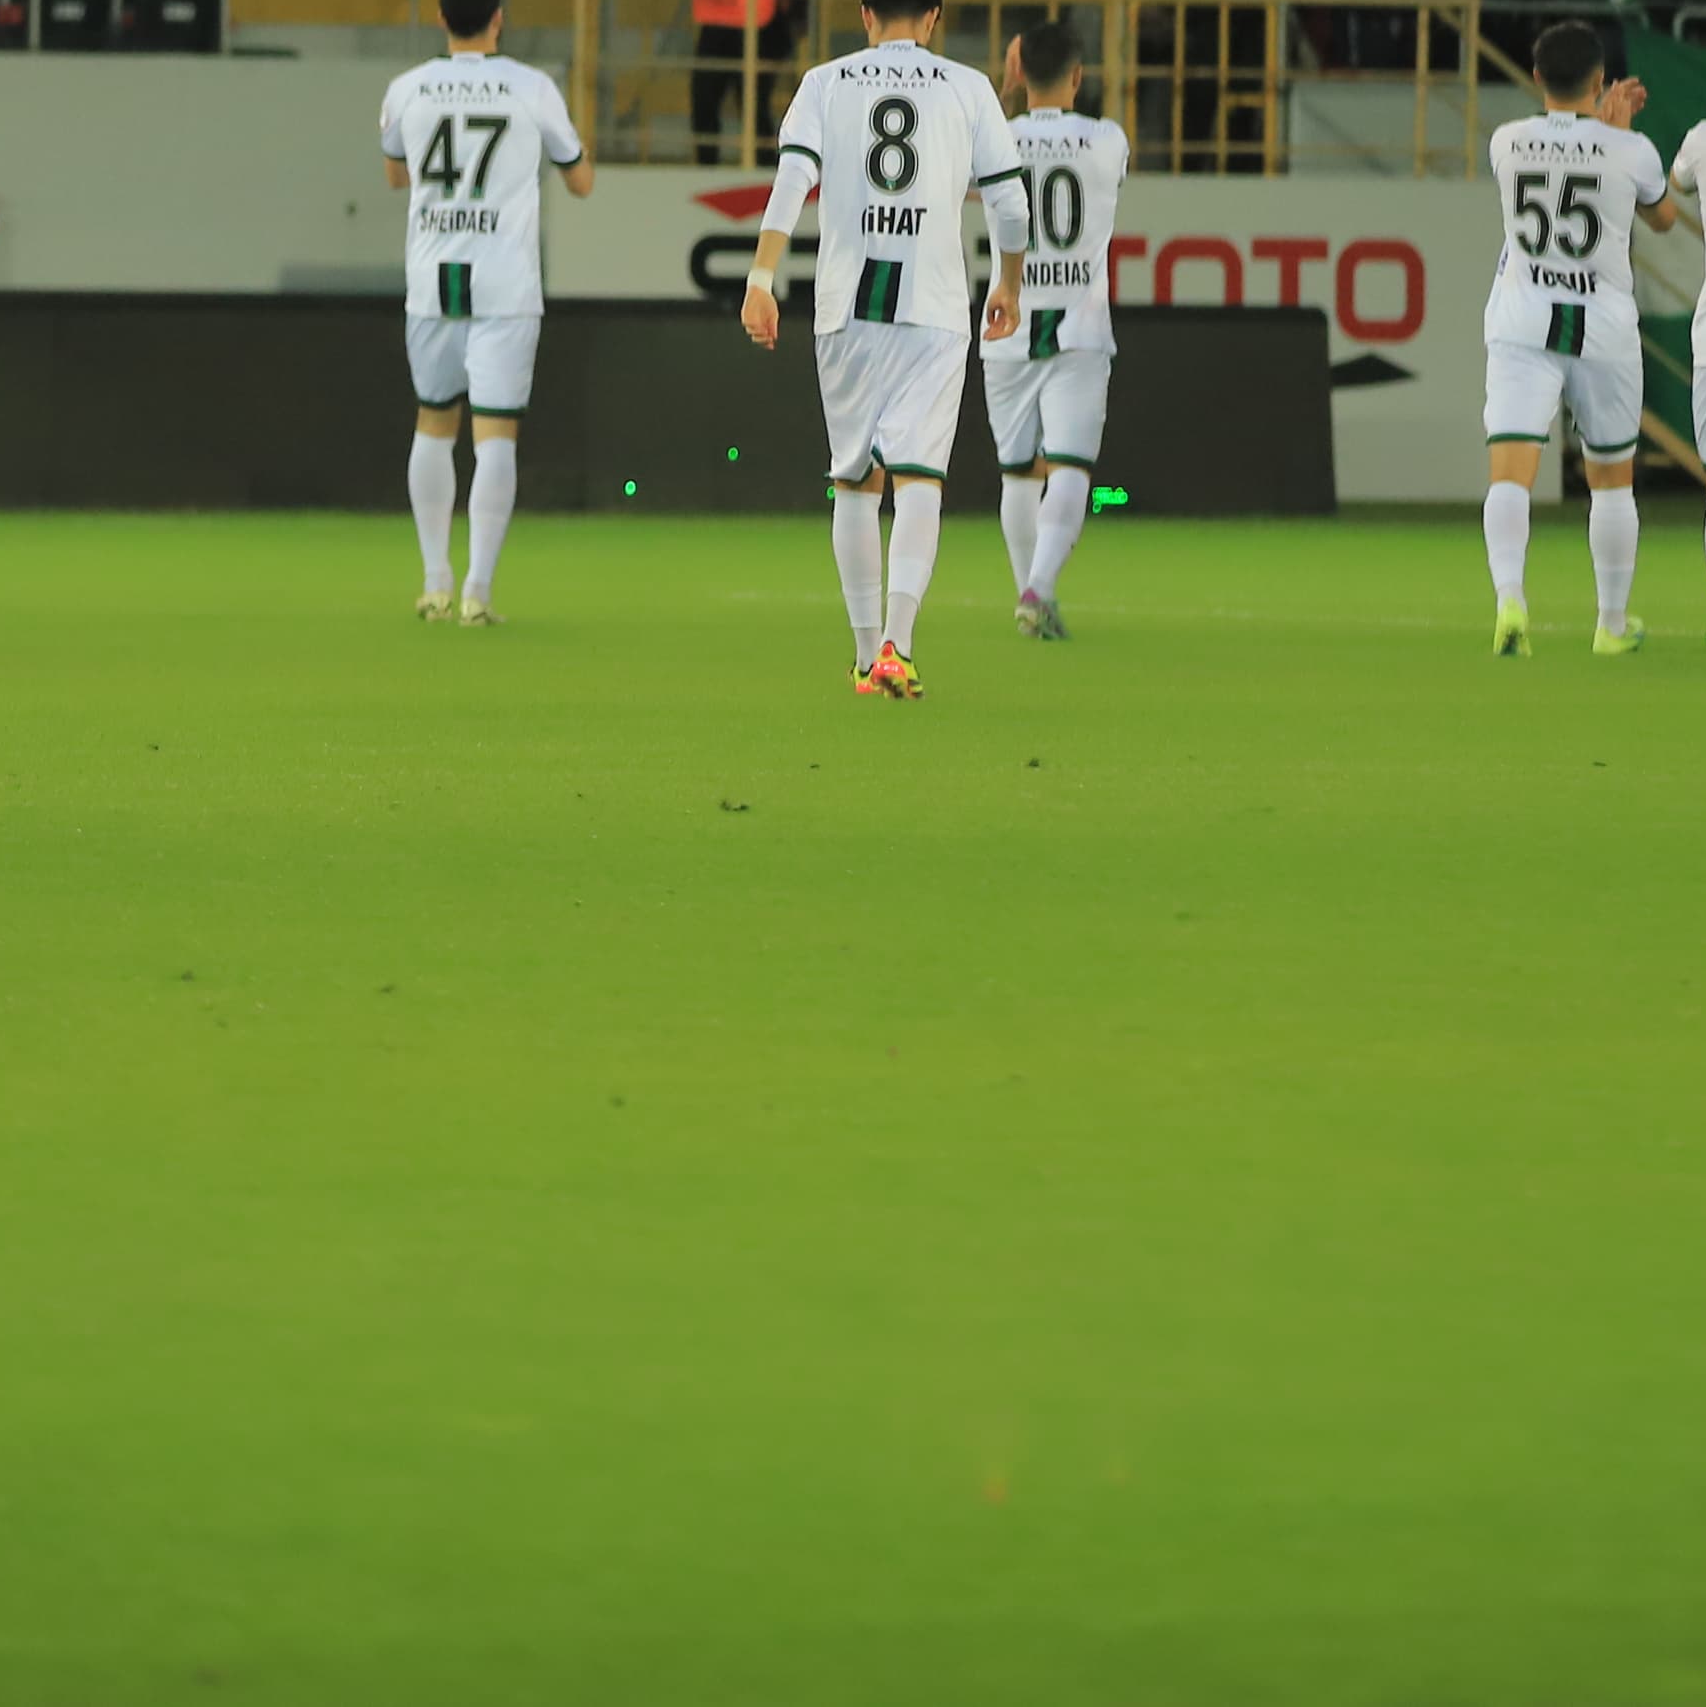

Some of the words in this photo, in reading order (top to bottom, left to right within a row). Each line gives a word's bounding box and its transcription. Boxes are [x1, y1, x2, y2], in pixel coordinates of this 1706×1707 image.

[840, 65, 950, 82] KONAK
[419, 82, 511, 96] KONAK
[865, 95, 919, 196] 8
[1015, 137, 1092, 151] ONAK
[1511, 140, 1606, 158] KONAK
[420, 114, 511, 201] 47
[1514, 170, 1603, 260] 55
[1021, 260, 1091, 287] NDEIAS
